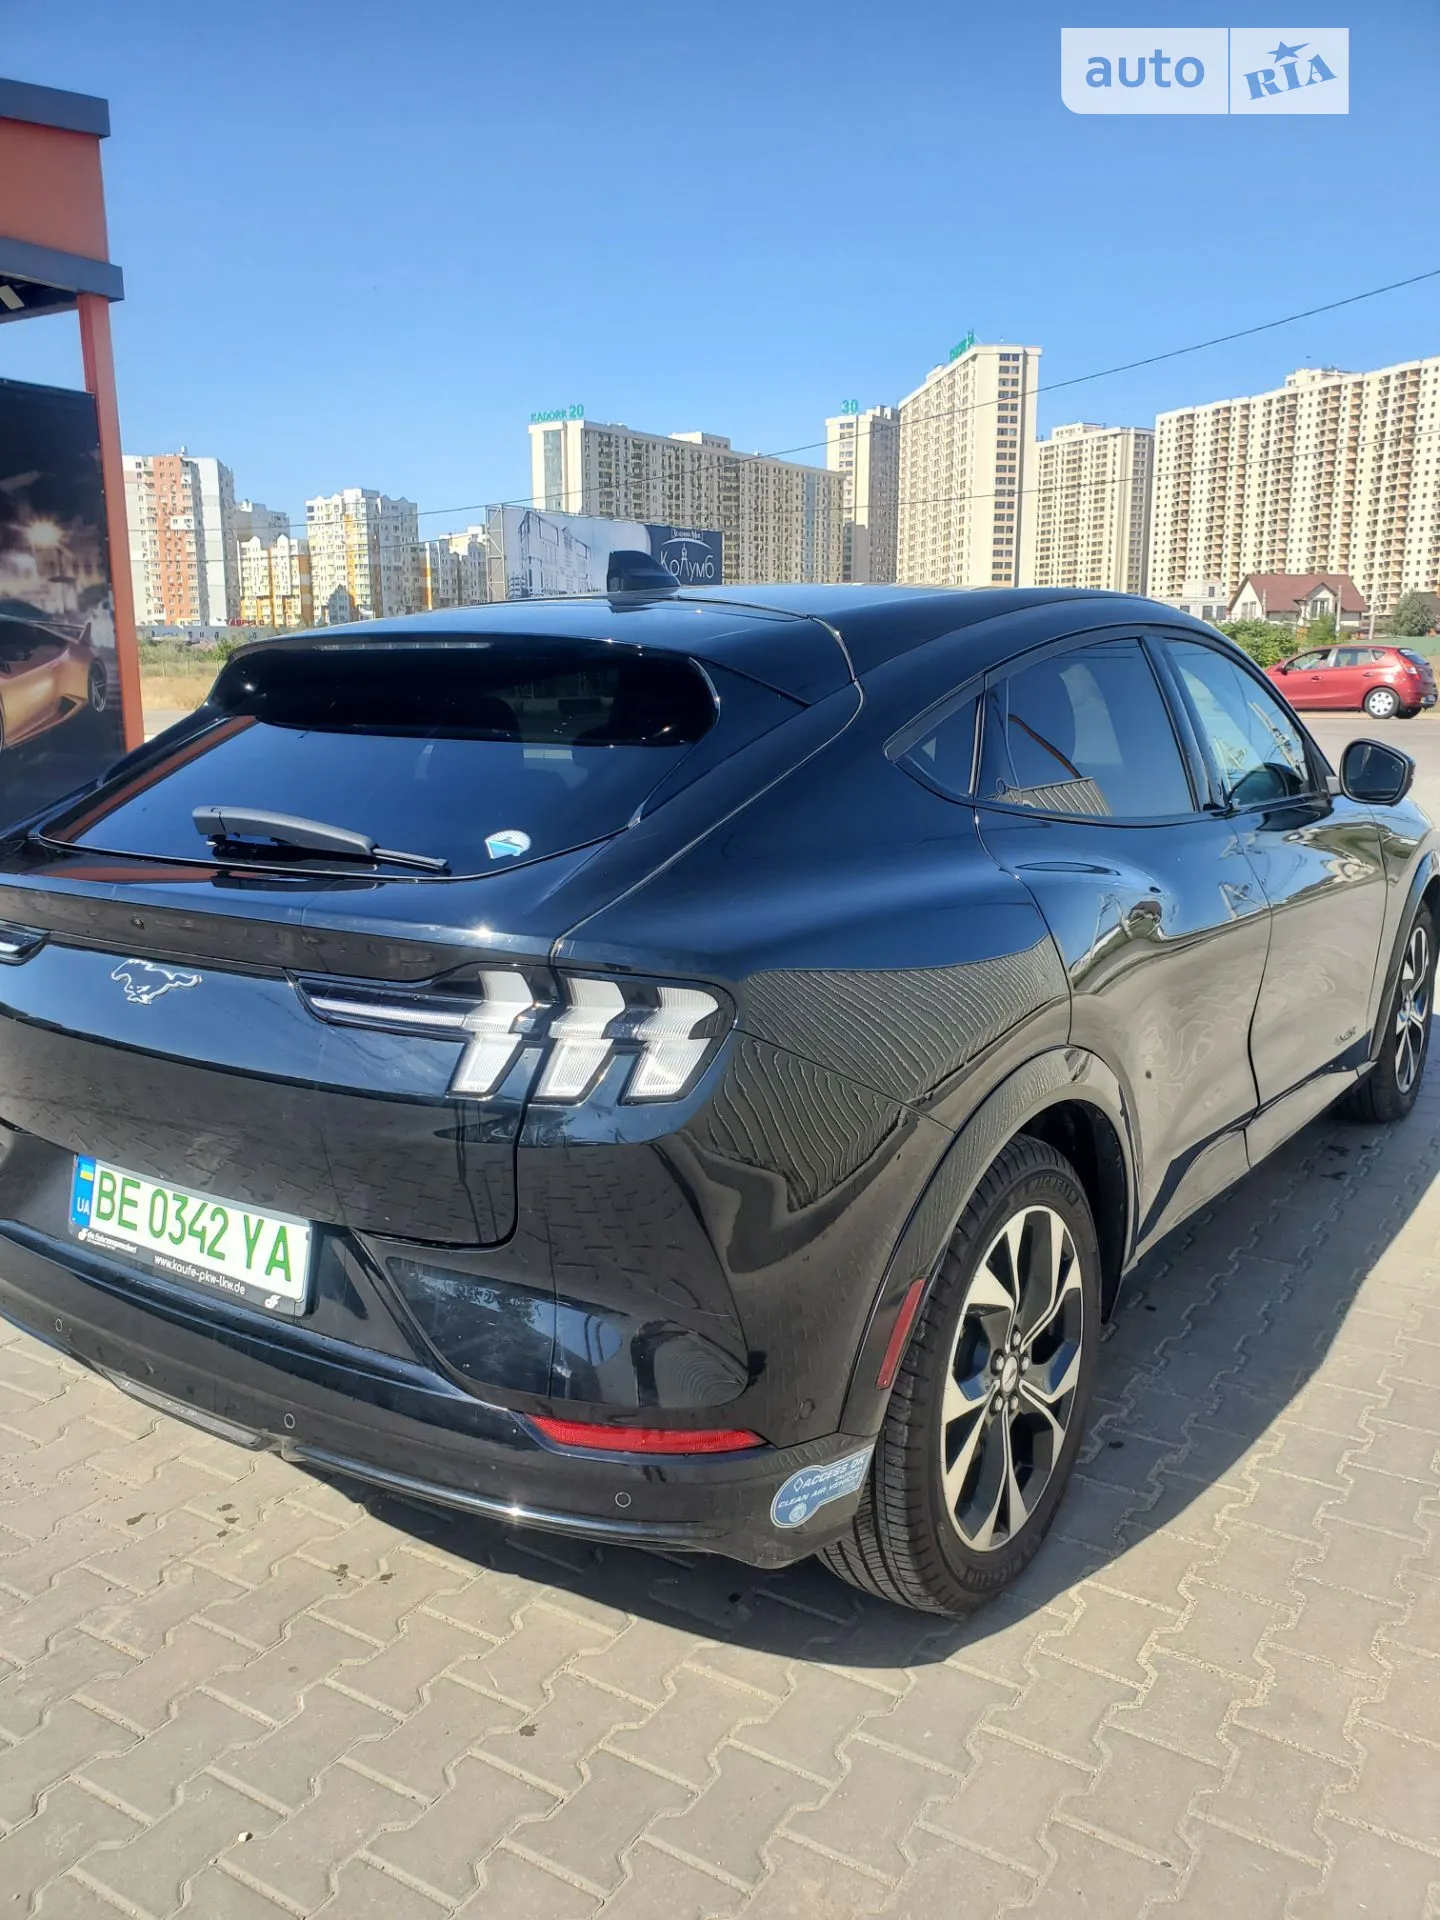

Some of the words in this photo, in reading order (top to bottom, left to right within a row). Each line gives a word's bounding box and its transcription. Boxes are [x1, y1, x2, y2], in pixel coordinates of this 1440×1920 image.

[531, 409, 567, 423] KADORR
[569, 404, 585, 419] 20
[841, 399, 859, 415] 30
[76, 1196, 91, 1216] UA
[96, 1171, 141, 1231] BE
[149, 1188, 229, 1261] 0342
[243, 1214, 292, 1282] YA
[154, 1254, 246, 1296] www.kaufe-pkw-lkw.de
[802, 1463, 849, 1489] ACCESS
[851, 1455, 866, 1469] OK
[778, 1492, 810, 1509] CLEAN
[810, 1487, 827, 1498] AIR
[829, 1472, 860, 1489] VEHICLE
